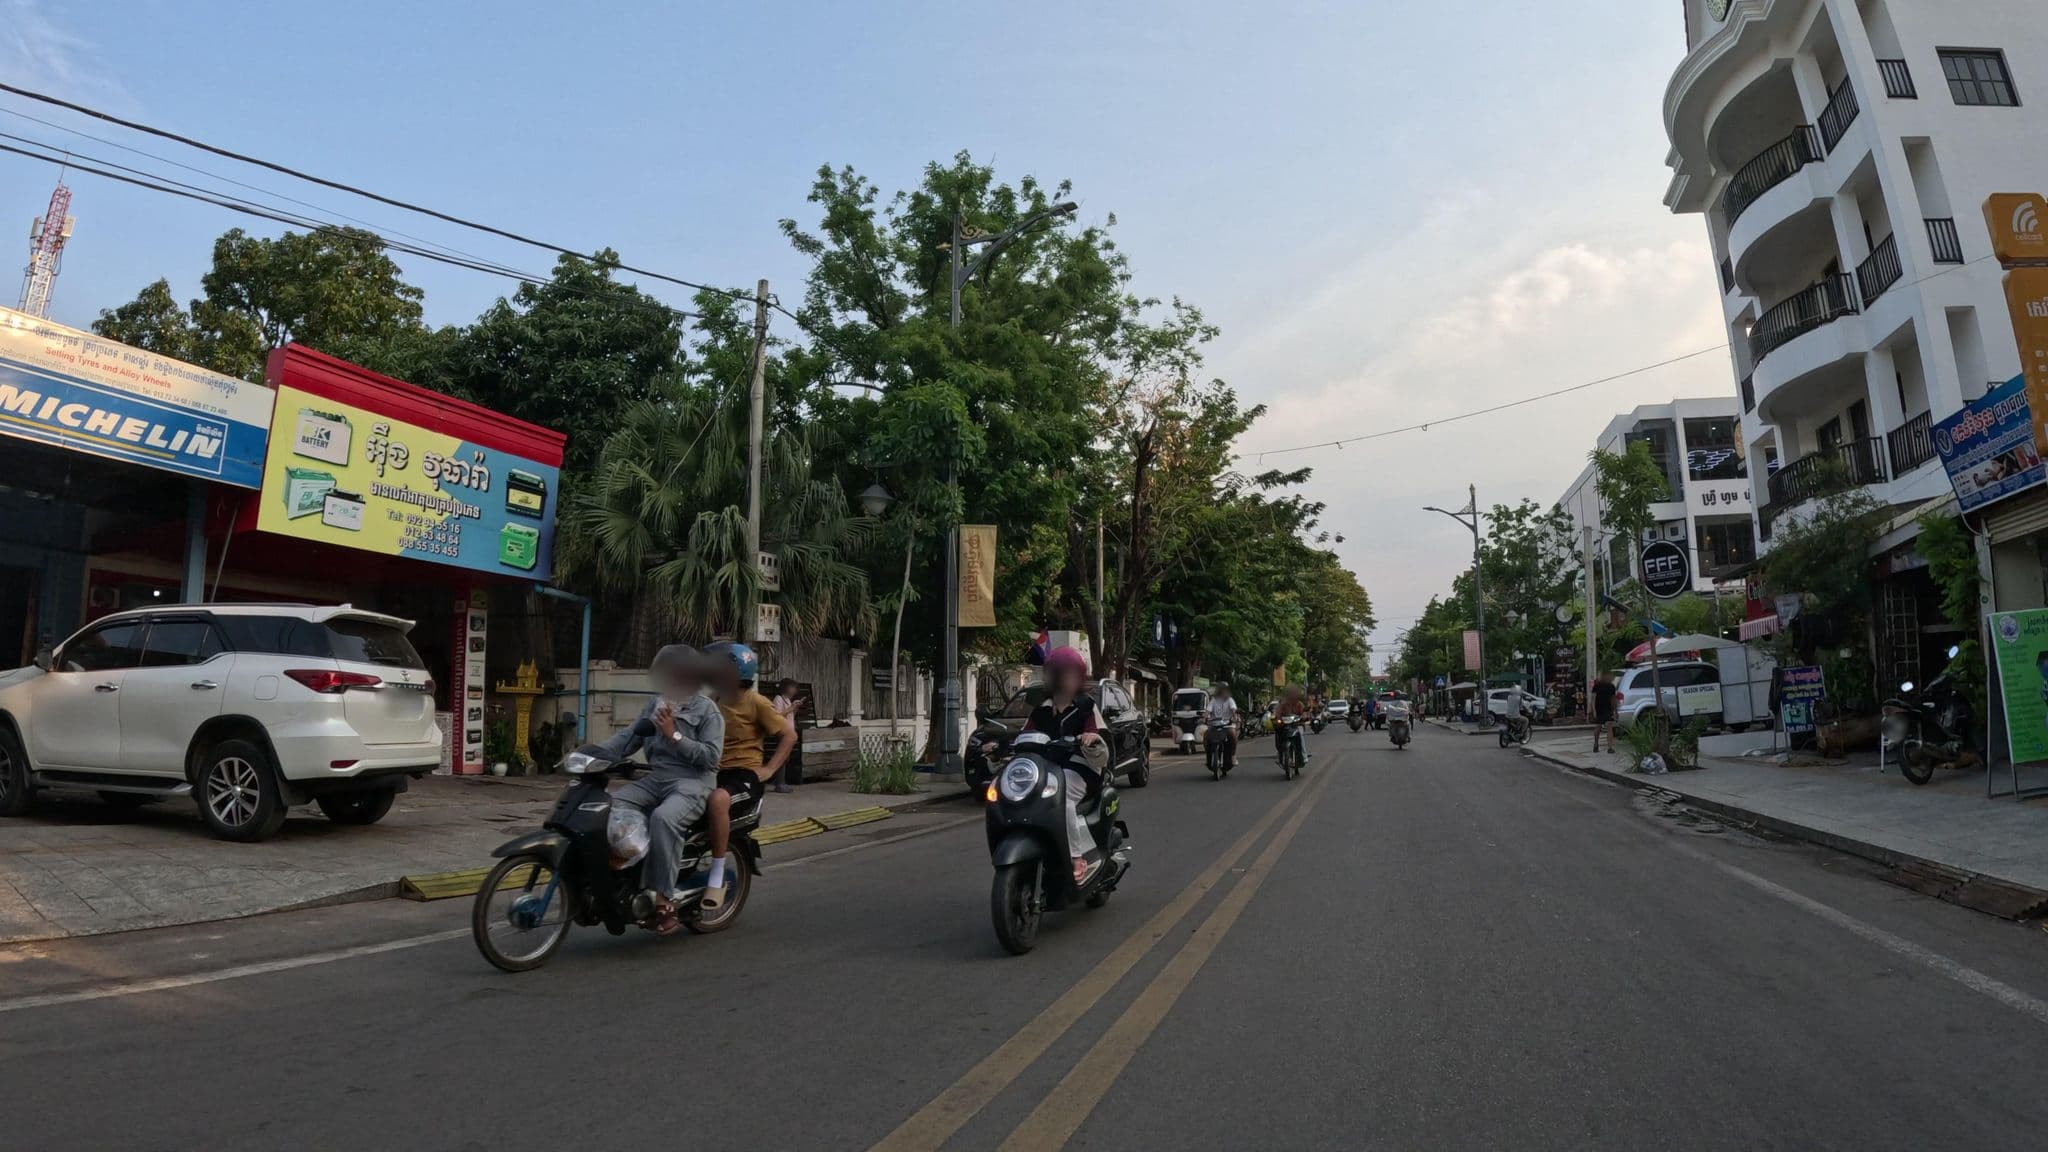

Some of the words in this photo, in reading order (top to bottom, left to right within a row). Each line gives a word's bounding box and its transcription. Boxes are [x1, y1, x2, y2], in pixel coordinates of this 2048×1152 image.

[45, 346, 76, 363] Selling
[78, 355, 100, 370] Tyres
[102, 364, 118, 374] and
[119, 368, 140, 381] Alloy
[142, 373, 172, 389] Wheels
[0, 384, 222, 459] MICHELIN
[301, 435, 329, 449] BATTERY
[406, 513, 423, 526] 092
[450, 523, 461, 534] 16
[405, 526, 422, 538] 012
[435, 532, 447, 544] 48
[448, 534, 459, 546] 64
[416, 540, 428, 552] 55
[429, 542, 441, 554] 35
[441, 545, 458, 558] 455
[1644, 555, 1679, 574] FFF
